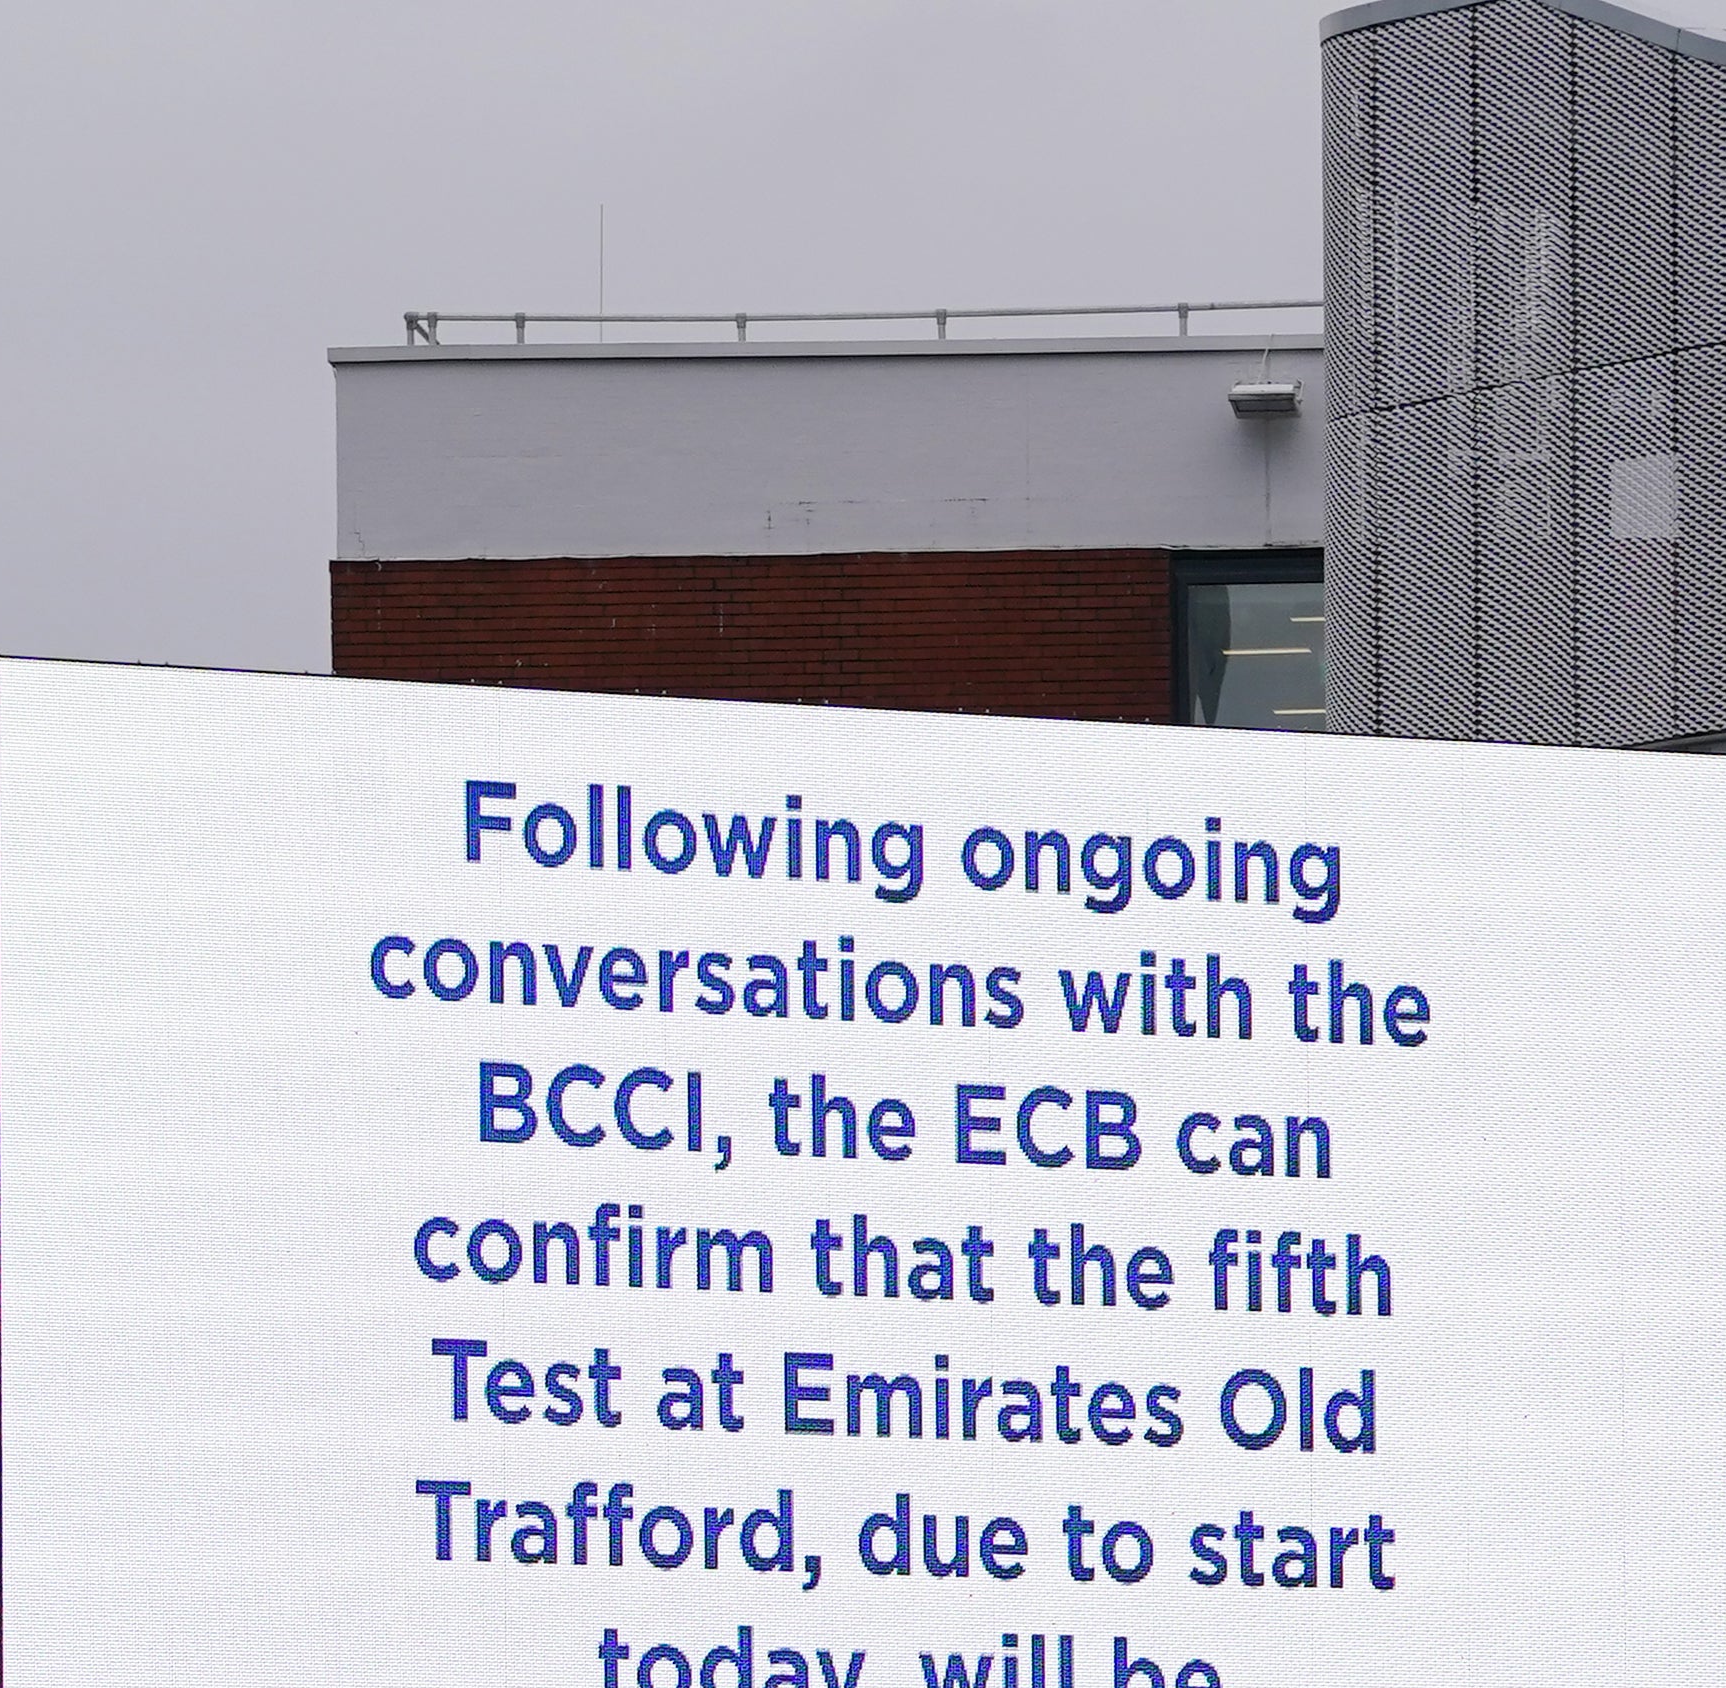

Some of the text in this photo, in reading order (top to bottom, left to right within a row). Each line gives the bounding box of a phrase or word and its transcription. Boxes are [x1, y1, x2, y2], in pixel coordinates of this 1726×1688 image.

[463, 779, 1341, 925] Following ongoing
[369, 934, 1431, 1047] conversations with the
[478, 1059, 1333, 1179] BCCI, the ECB can
[413, 1202, 1394, 1316] confirm that the fifth
[432, 1337, 1379, 1454] Test at Emirates Old
[416, 1479, 1396, 1591] Trafford, due to start
